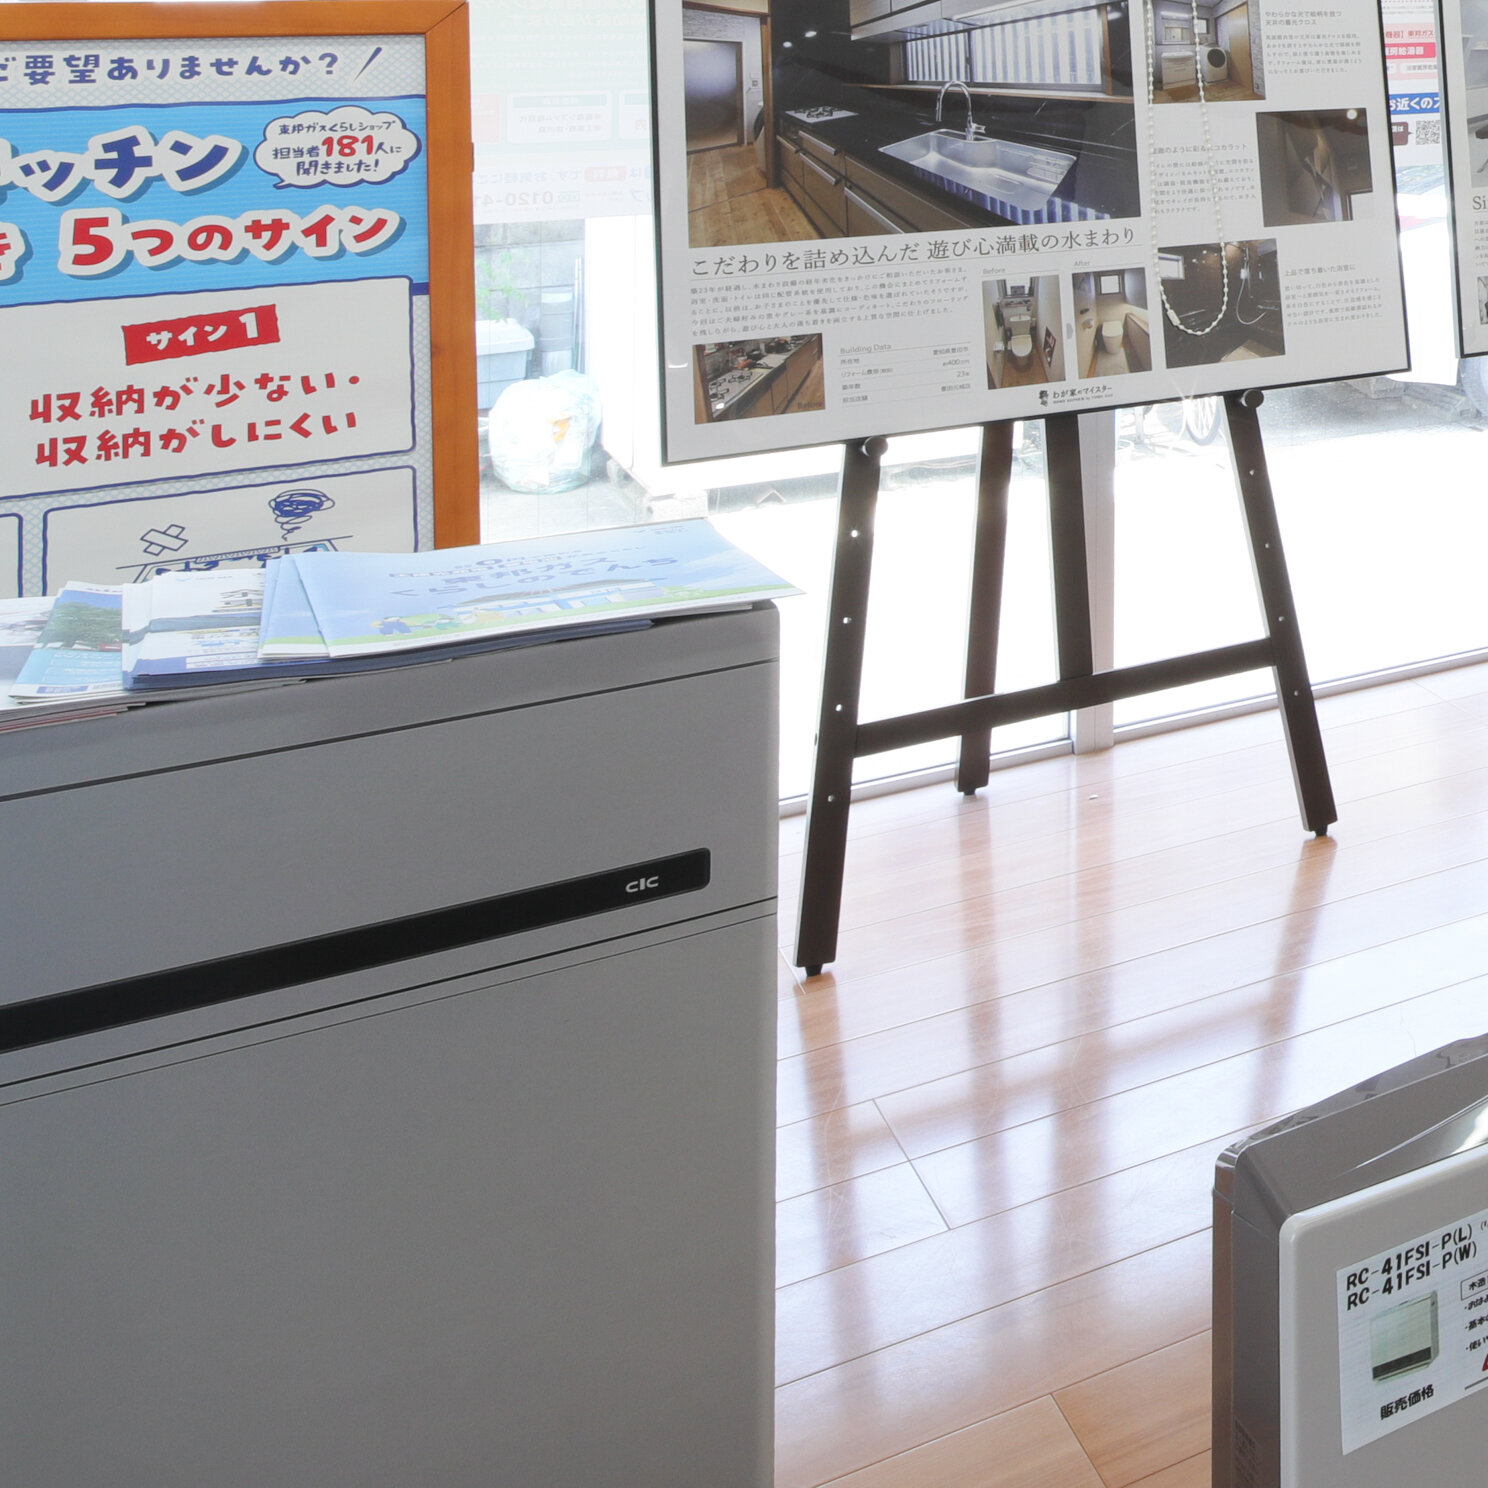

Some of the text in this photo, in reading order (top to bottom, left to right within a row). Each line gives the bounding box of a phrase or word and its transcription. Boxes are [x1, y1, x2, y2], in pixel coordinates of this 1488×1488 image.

[272, 135, 403, 160] 担当者181人に
[278, 119, 396, 135] 東邦ガスくらしショップ
[21, 132, 230, 193] ッチン
[296, 159, 380, 176] 聞きました!
[71, 213, 389, 267] 5つのサイン
[692, 226, 1135, 276] こだわりを詰め込んだ 遊び心満載の水まわり
[36, 412, 357, 467] 収納がしにくい
[1346, 1224, 1472, 1291] RC-41FSI-P(L)
[1347, 1241, 1477, 1310] RC-41FSI-P(W)
[1380, 1384, 1435, 1421] 販売価格
